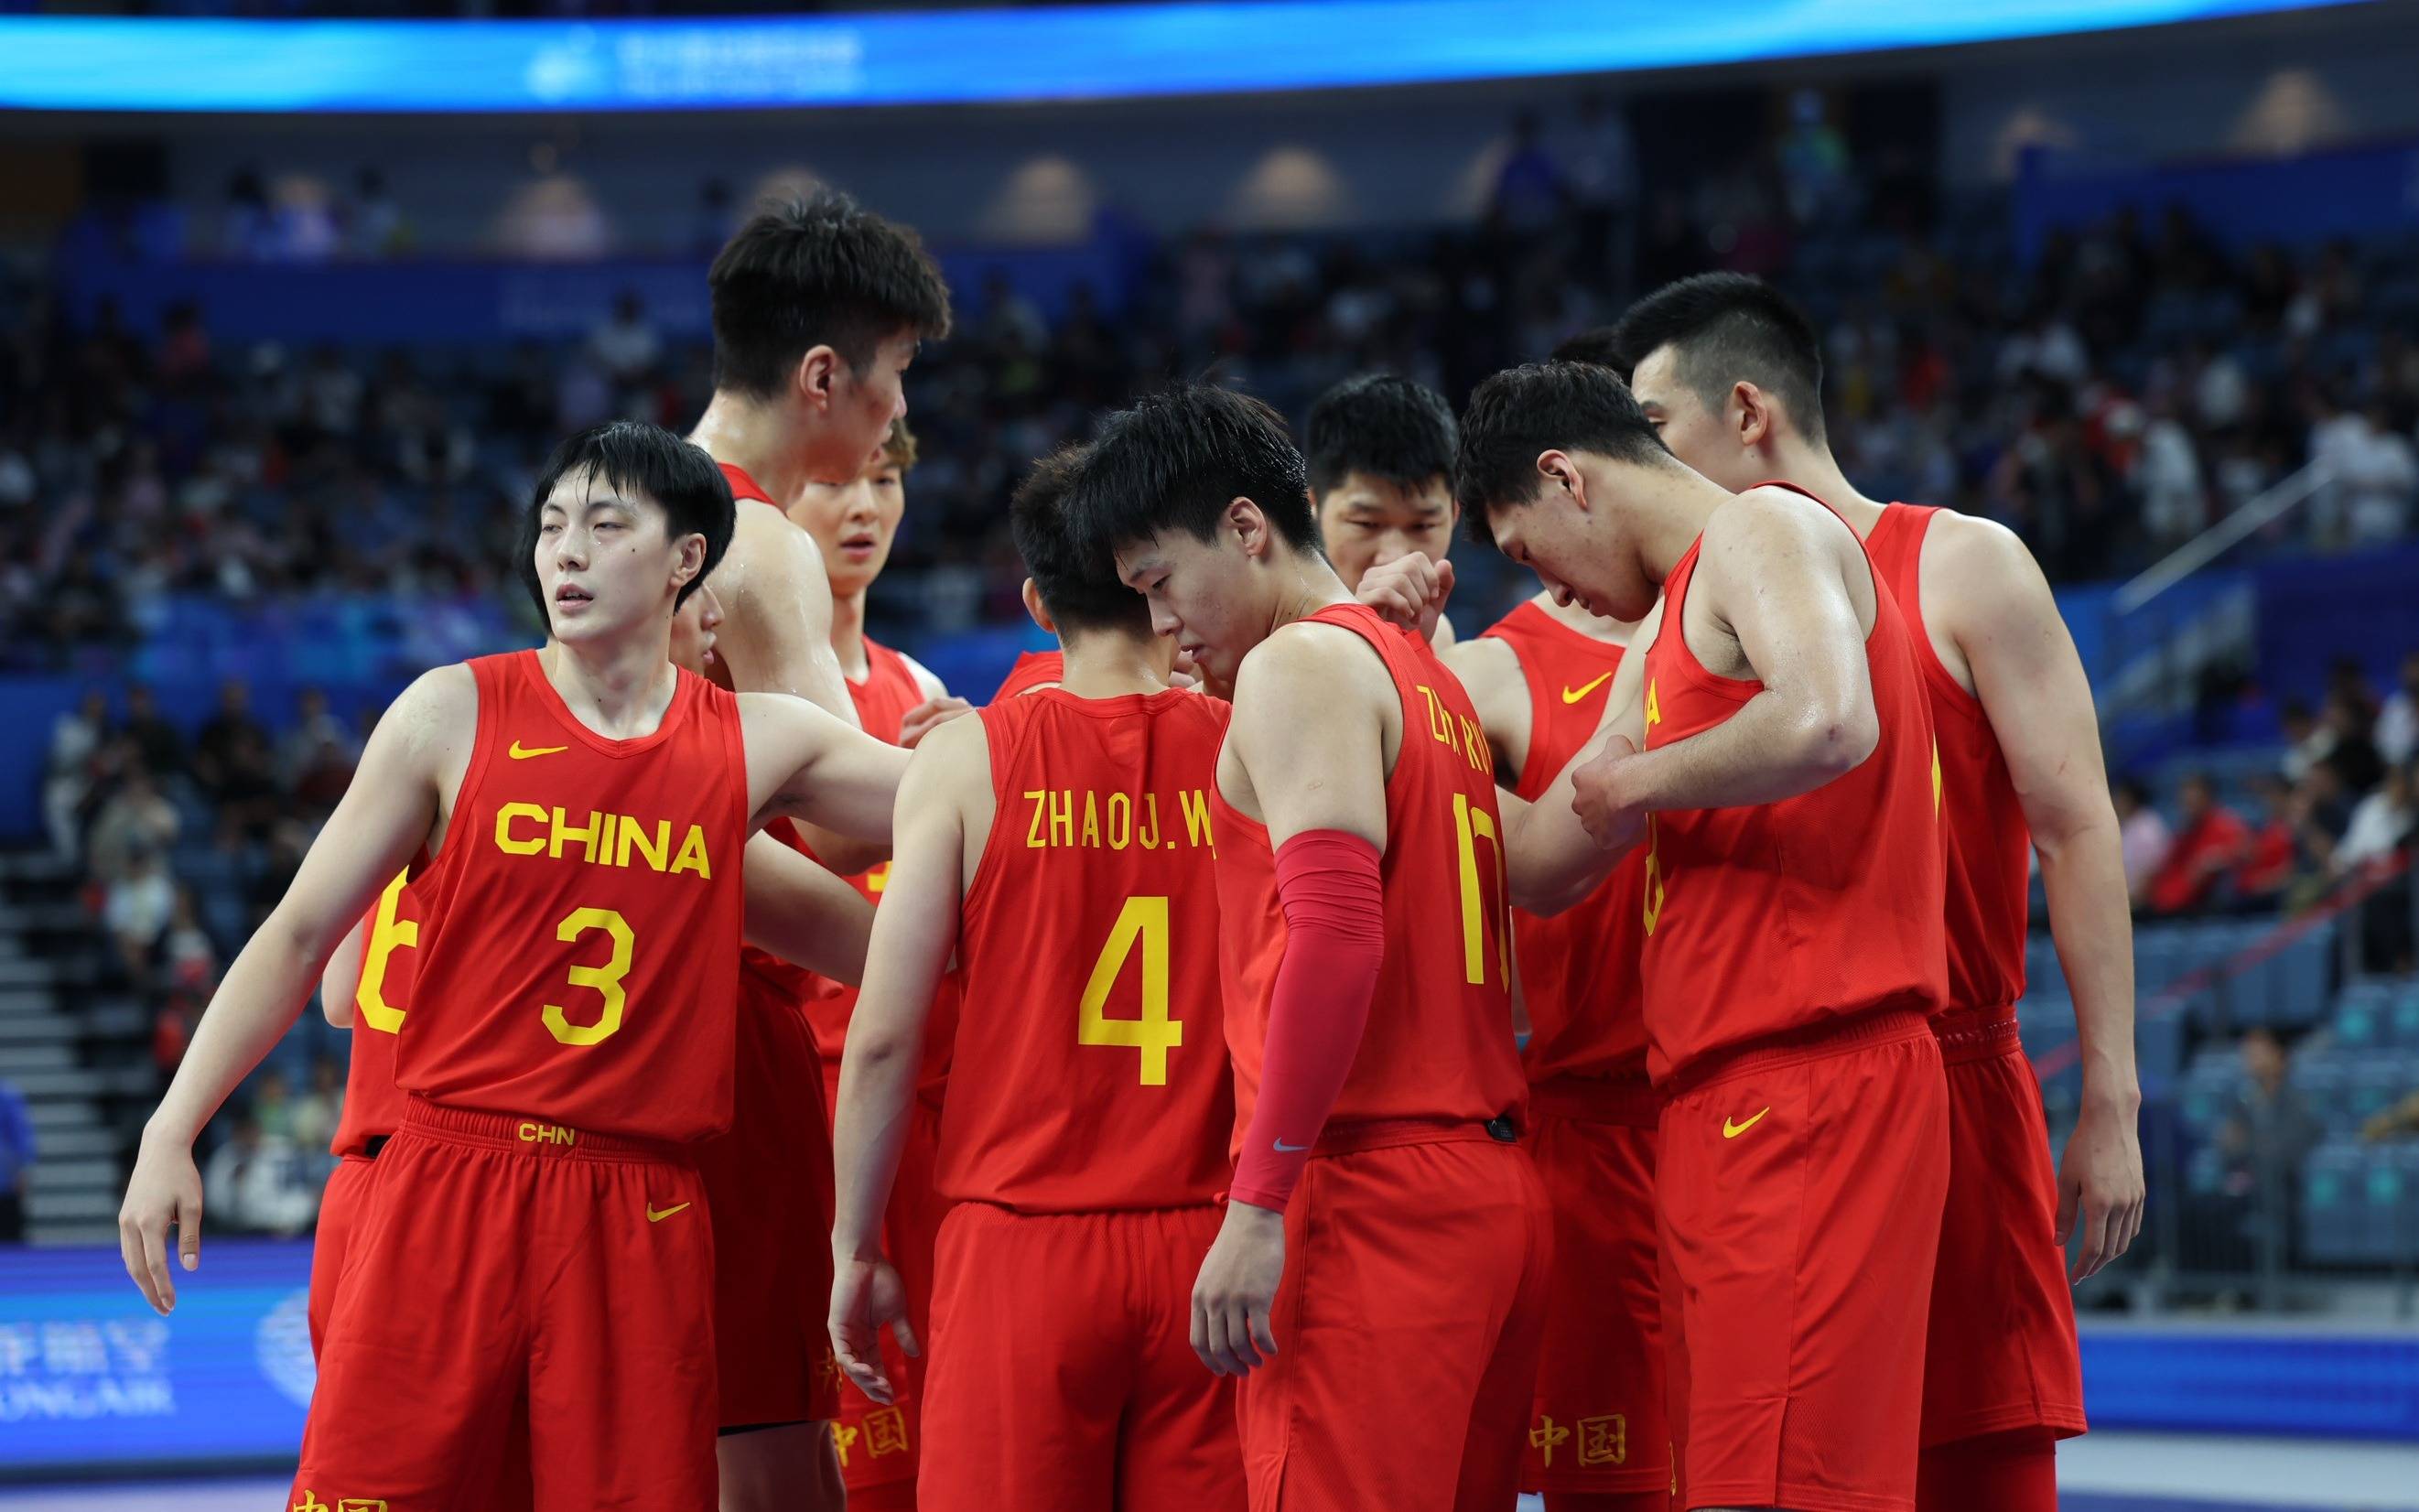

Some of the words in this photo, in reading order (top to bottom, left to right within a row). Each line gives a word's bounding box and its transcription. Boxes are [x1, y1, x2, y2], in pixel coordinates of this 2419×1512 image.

[494, 802, 711, 880] CHINA
[541, 907, 635, 1046] 3
[1077, 896, 1183, 1085] 4
[518, 1122, 576, 1146] CHN
[1528, 1413, 1625, 1469] 中国
